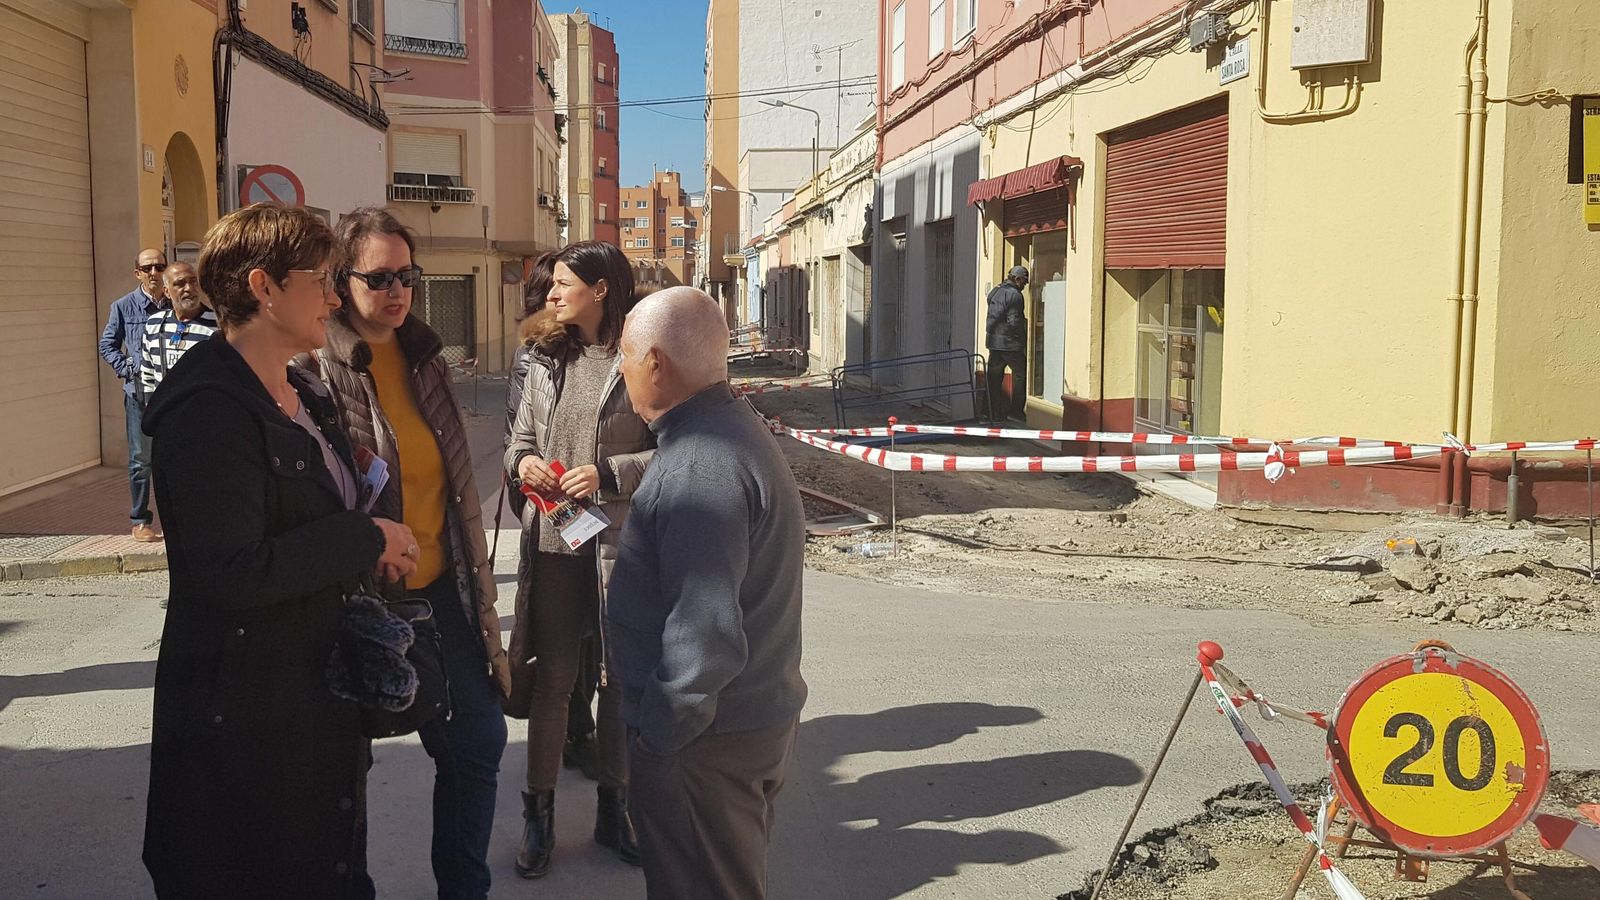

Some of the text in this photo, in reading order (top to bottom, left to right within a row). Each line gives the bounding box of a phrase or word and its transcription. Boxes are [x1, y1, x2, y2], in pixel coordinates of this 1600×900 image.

[1221, 58, 1245, 79] SANTA ROSA
[1382, 711, 1496, 792] 20
